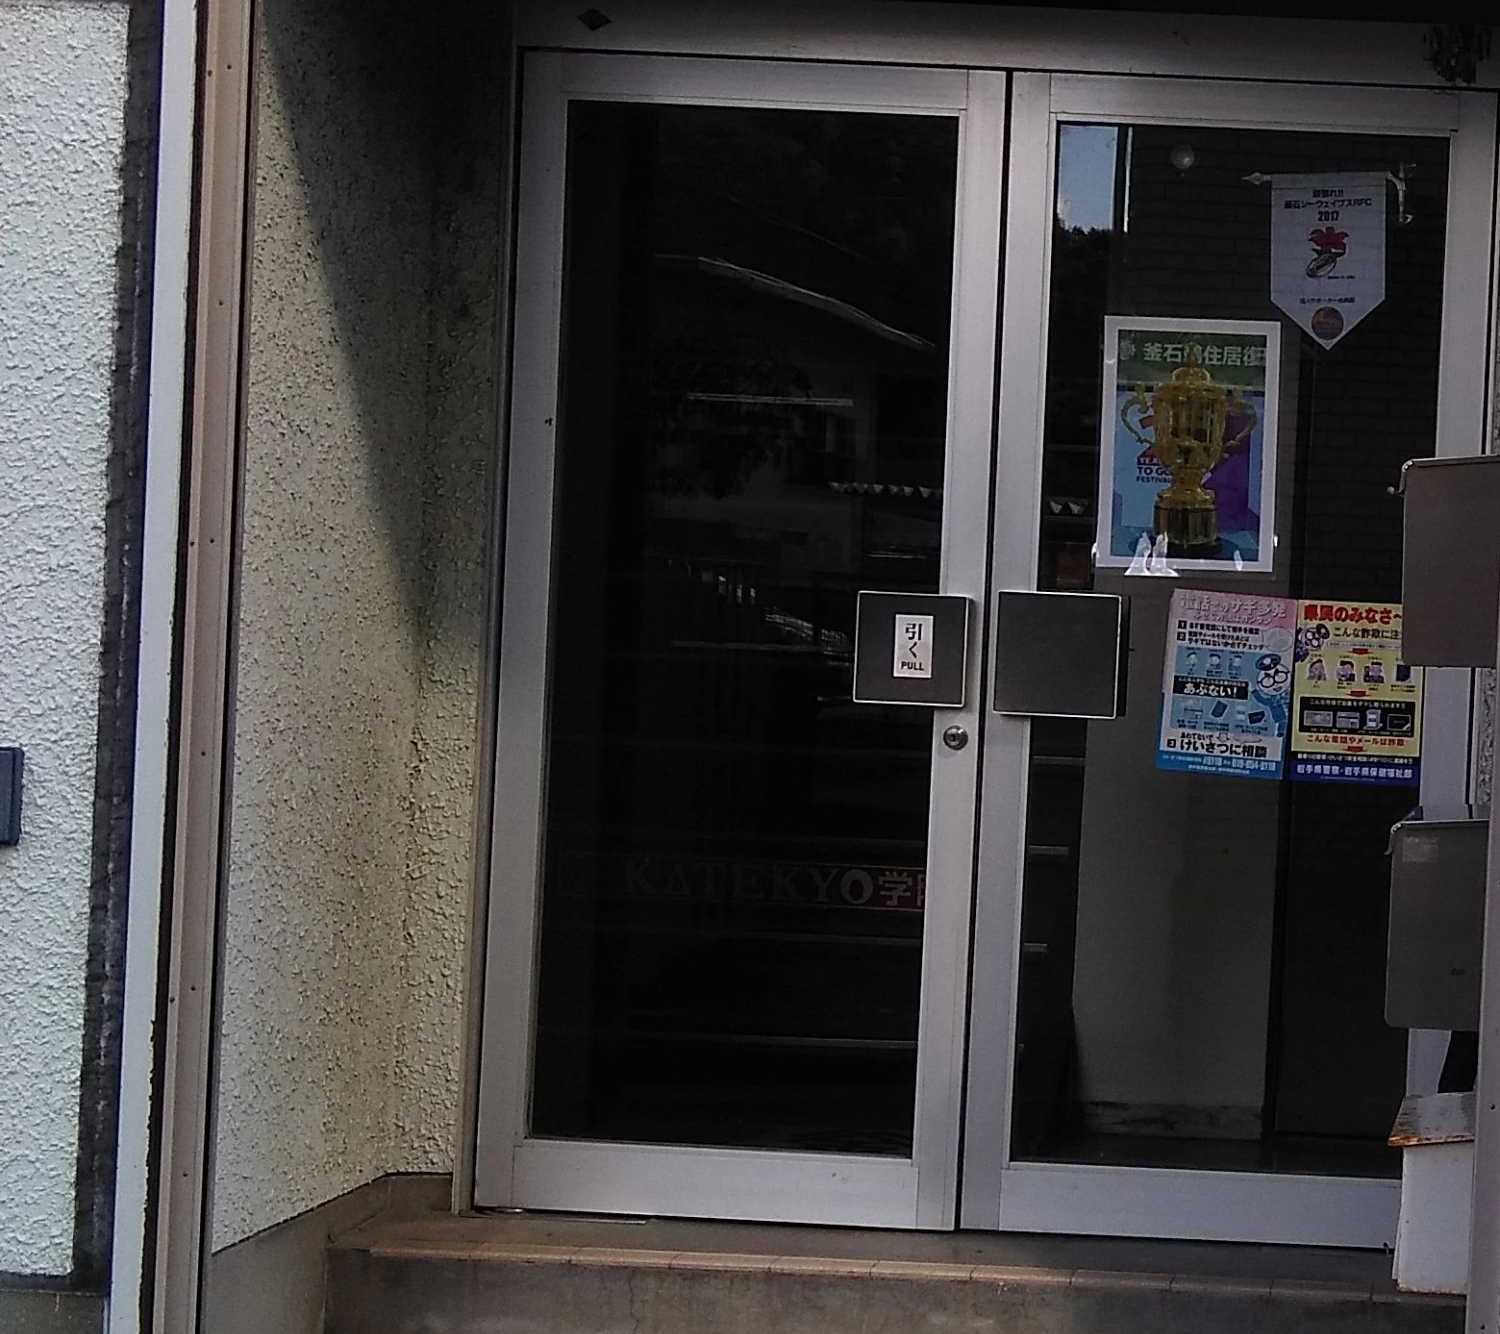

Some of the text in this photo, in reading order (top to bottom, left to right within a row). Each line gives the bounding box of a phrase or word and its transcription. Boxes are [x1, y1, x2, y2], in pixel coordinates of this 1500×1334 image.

[1317, 210, 1339, 222] 2017
[1137, 466, 1153, 475] TO
[905, 623, 923, 659] 引く
[901, 661, 924, 671] PULL
[1183, 683, 1237, 697] あぶない!
[1180, 738, 1267, 758] けいさつに相談
